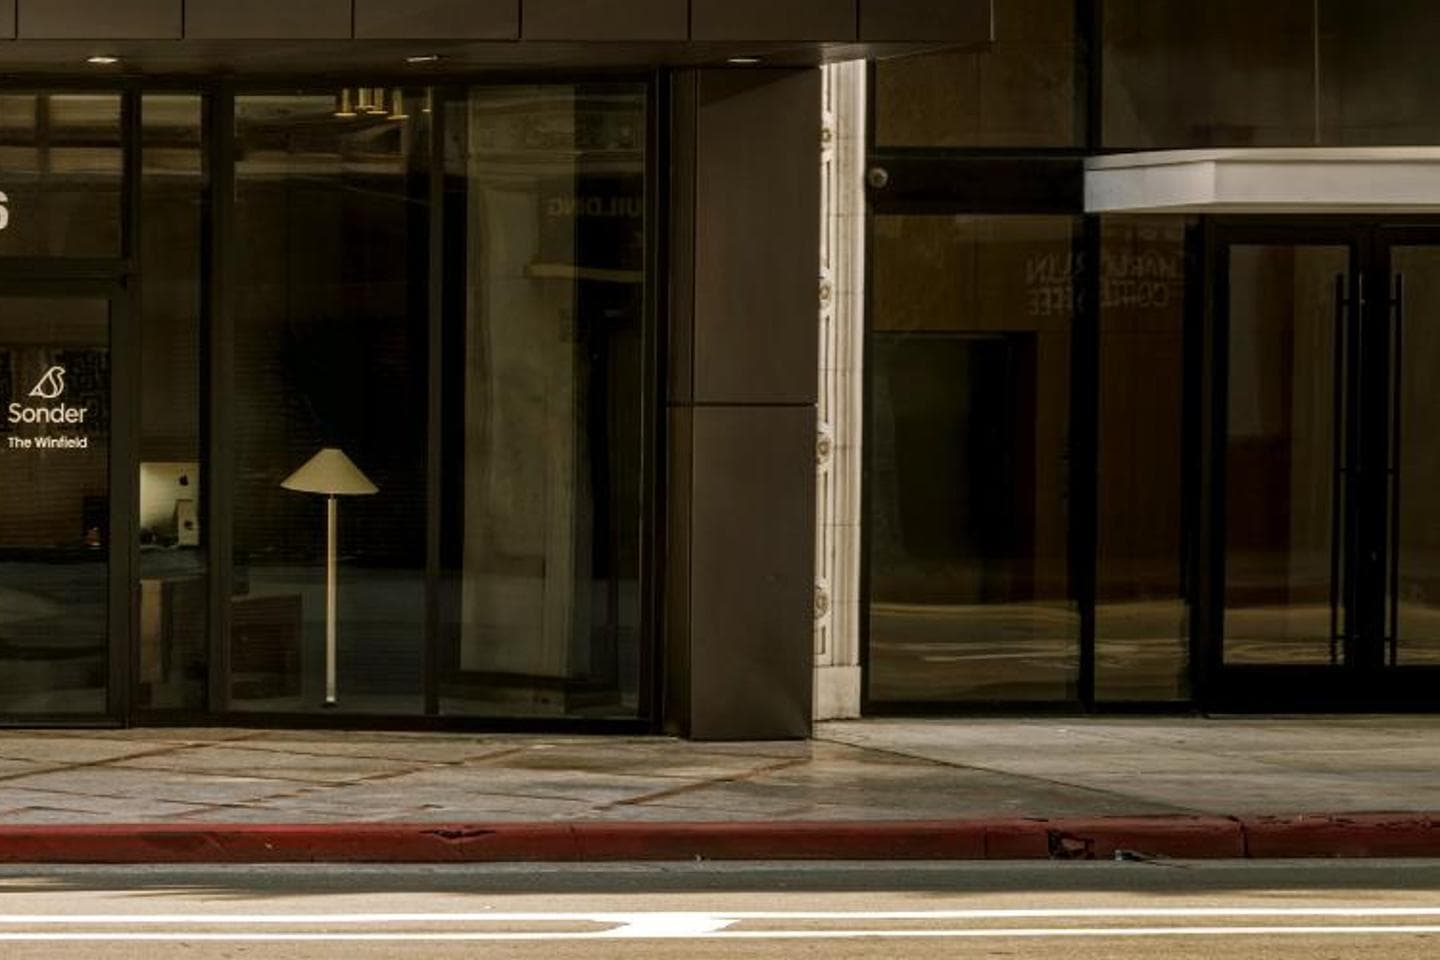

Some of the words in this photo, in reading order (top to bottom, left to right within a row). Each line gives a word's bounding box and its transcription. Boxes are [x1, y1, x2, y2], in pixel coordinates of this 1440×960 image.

[7, 403, 88, 424] Sonder
[8, 437, 33, 449] The
[34, 437, 88, 449] Winfield
